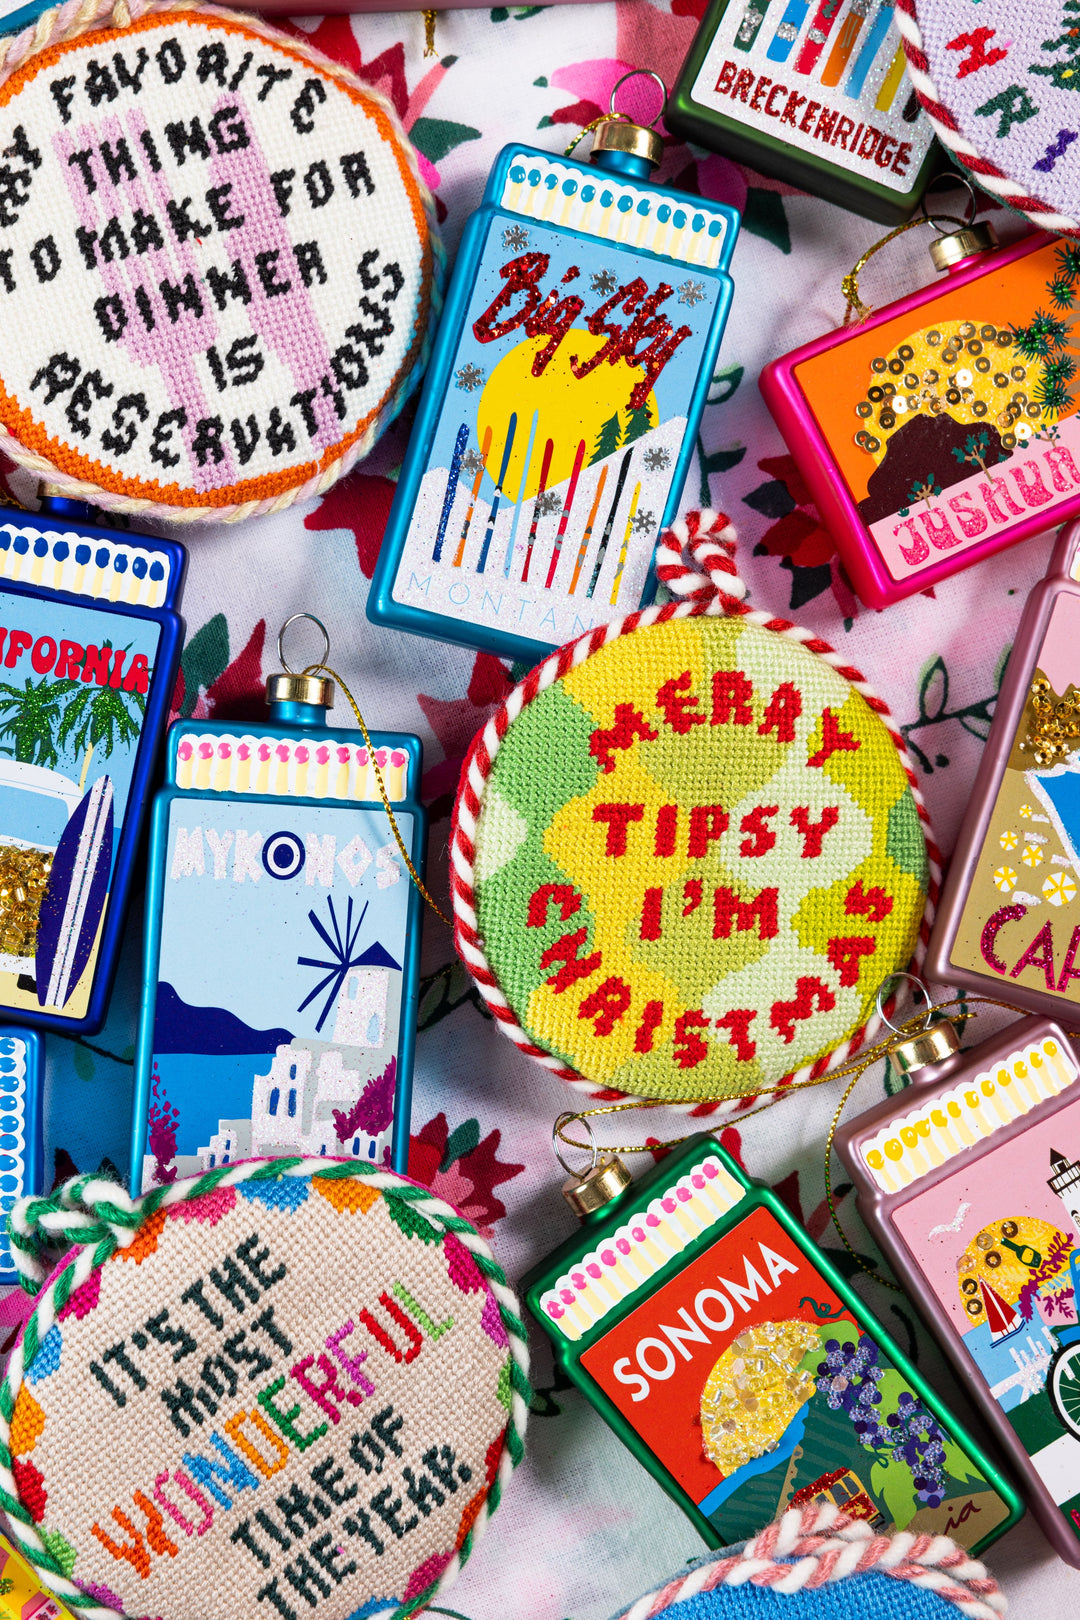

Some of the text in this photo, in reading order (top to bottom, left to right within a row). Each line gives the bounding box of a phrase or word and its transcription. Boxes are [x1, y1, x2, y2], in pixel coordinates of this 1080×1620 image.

[49, 38, 327, 134] FAVORITE
[714, 60, 913, 176] BRECKENRIDGE
[69, 105, 250, 194] THING
[0, 151, 375, 294] TO MAKE FOR
[94, 241, 327, 343] DINNER
[472, 252, 693, 410] Big Sky
[30, 249, 403, 468] RESERVATIONS
[206, 334, 264, 391] IS
[408, 571, 594, 635] MONTAN
[589, 671, 860, 773] MERRY
[170, 826, 402, 890] MYKONOS
[592, 803, 838, 858] TIPSY
[639, 879, 780, 940] I'M
[527, 880, 894, 1068] CHRISTMAS
[90, 1233, 287, 1407] IT'S THE
[161, 1307, 293, 1437] MOST
[612, 1241, 800, 1402] SONOMA
[91, 1282, 454, 1579] WONDERFUL
[230, 1405, 404, 1568] TIME OF
[257, 1532, 357, 1620] THE
